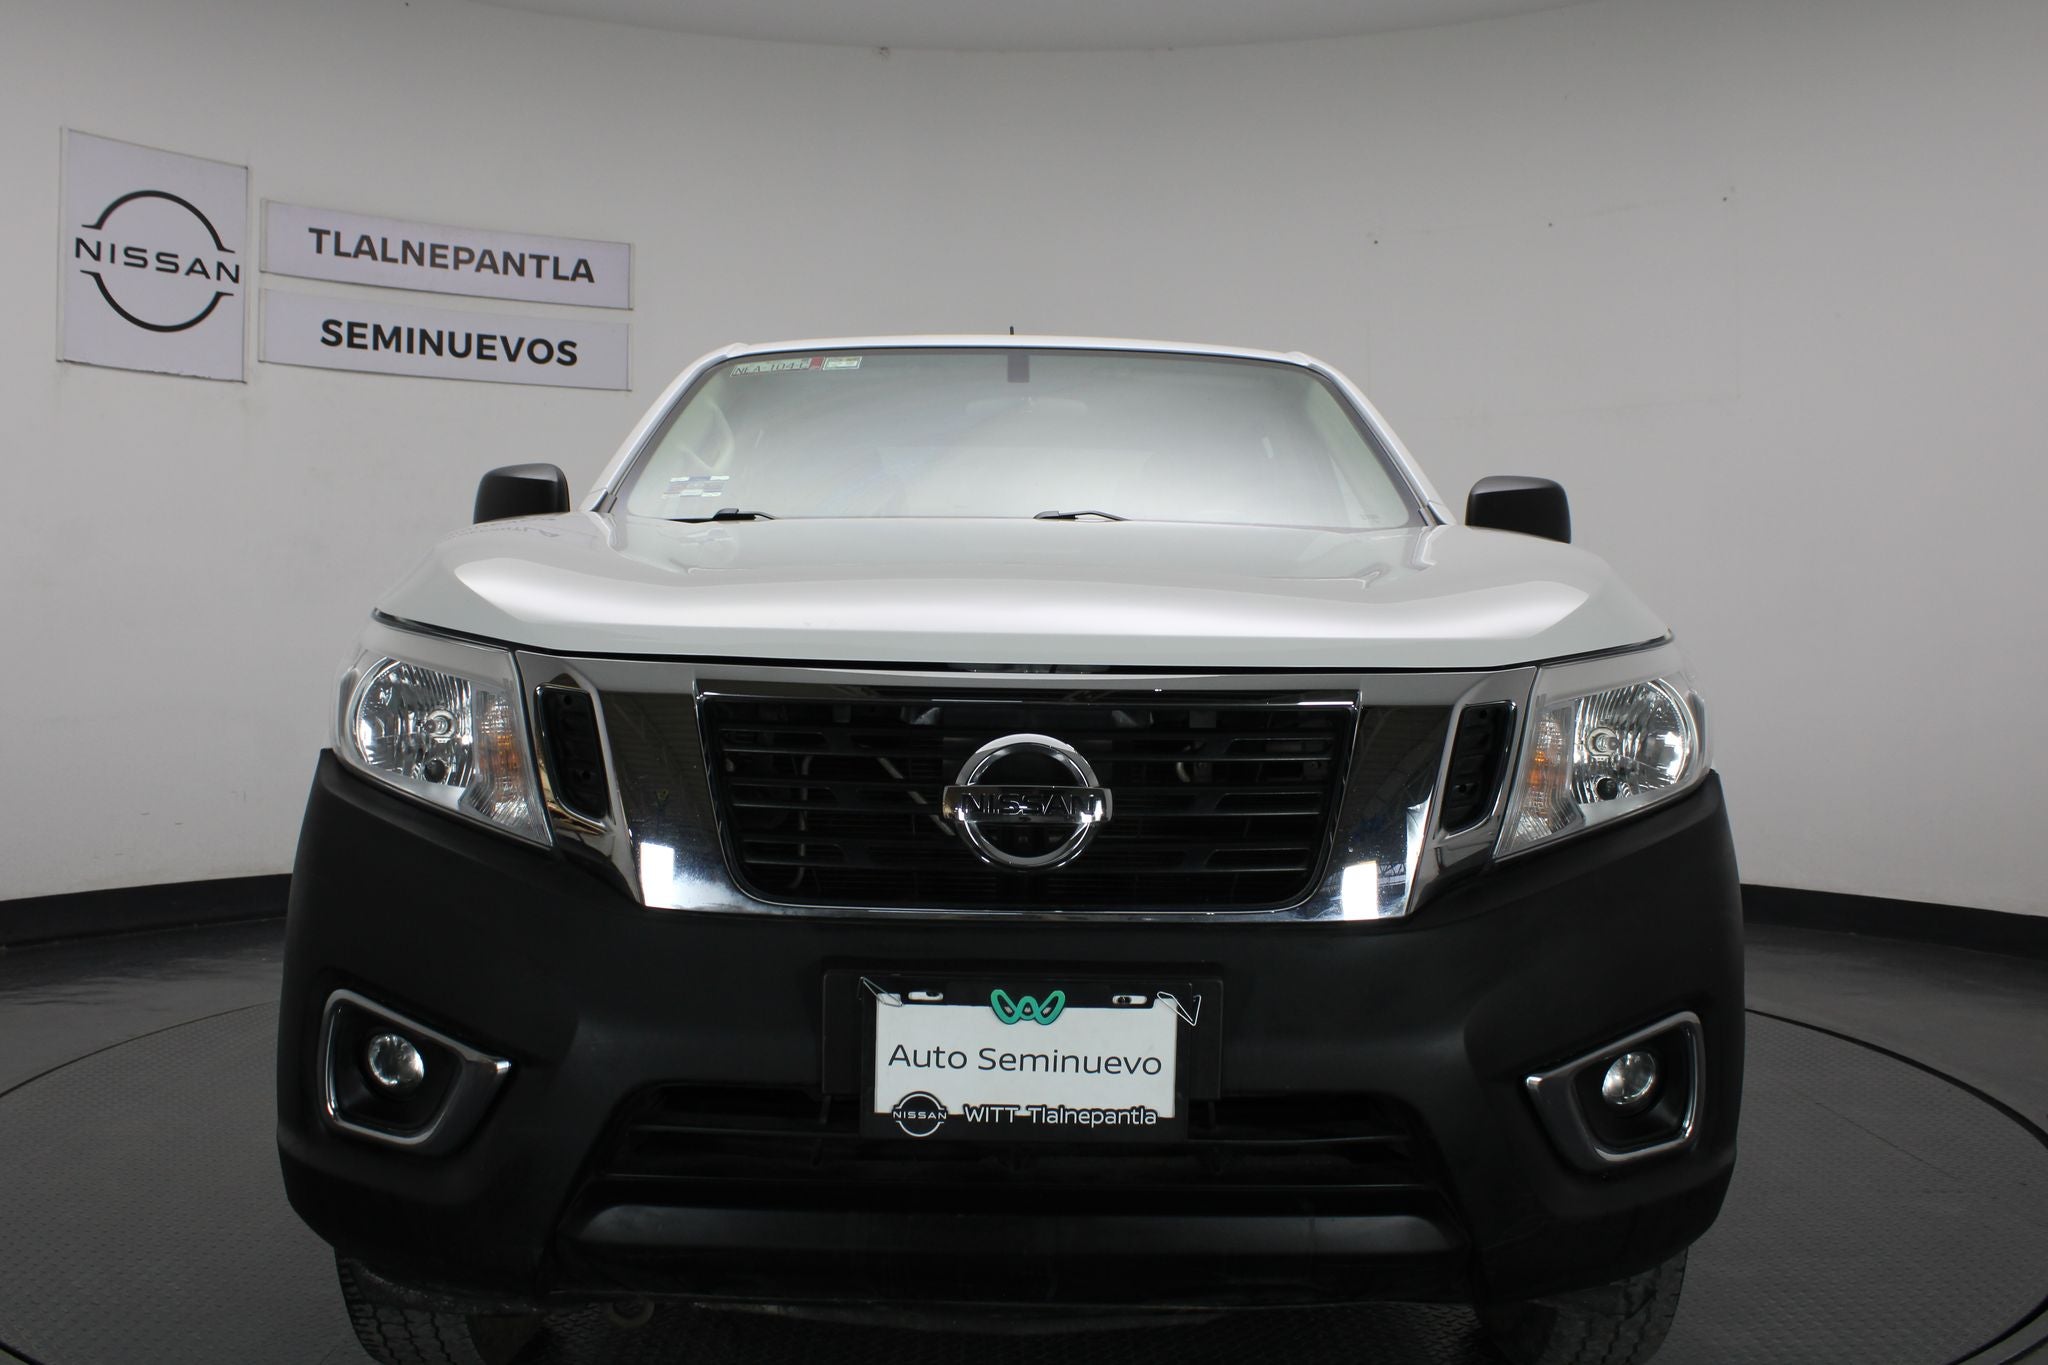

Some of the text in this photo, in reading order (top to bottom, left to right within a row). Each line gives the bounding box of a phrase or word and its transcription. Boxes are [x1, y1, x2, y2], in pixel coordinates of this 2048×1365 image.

[75, 237, 239, 283] NISSAN
[309, 228, 594, 283] TLALNEPANTLA
[321, 319, 577, 366] SEMINUEVOS
[961, 793, 1090, 816] NISSAN
[889, 1045, 1161, 1075] Auto Seminuevo
[893, 1111, 946, 1120] NISSAN
[965, 1106, 1157, 1128] WITT Tlalnepantla
